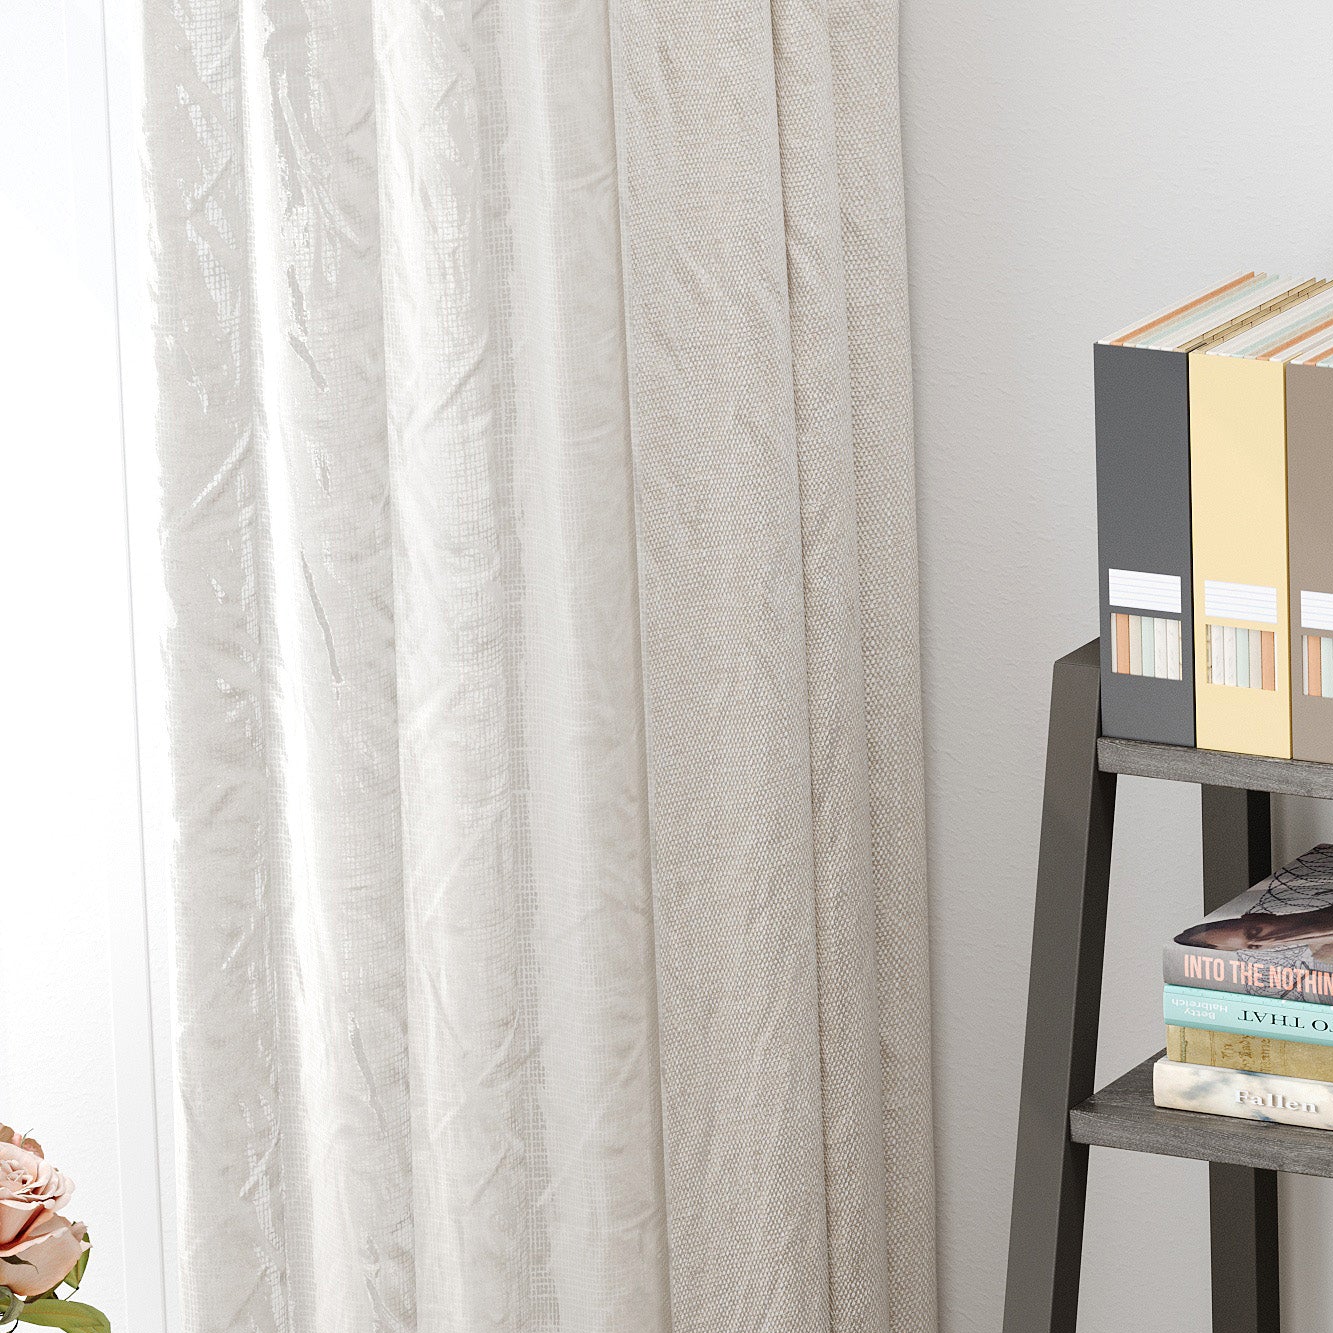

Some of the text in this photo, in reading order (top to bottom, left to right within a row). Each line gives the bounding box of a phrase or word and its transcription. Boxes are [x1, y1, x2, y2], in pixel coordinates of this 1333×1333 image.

[1184, 954, 1225, 982] INTO
[1229, 960, 1265, 987] THE
[1183, 1007, 1217, 1021] Betty
[1237, 1009, 1305, 1029] THAT
[1235, 1089, 1319, 1113] Fallen
